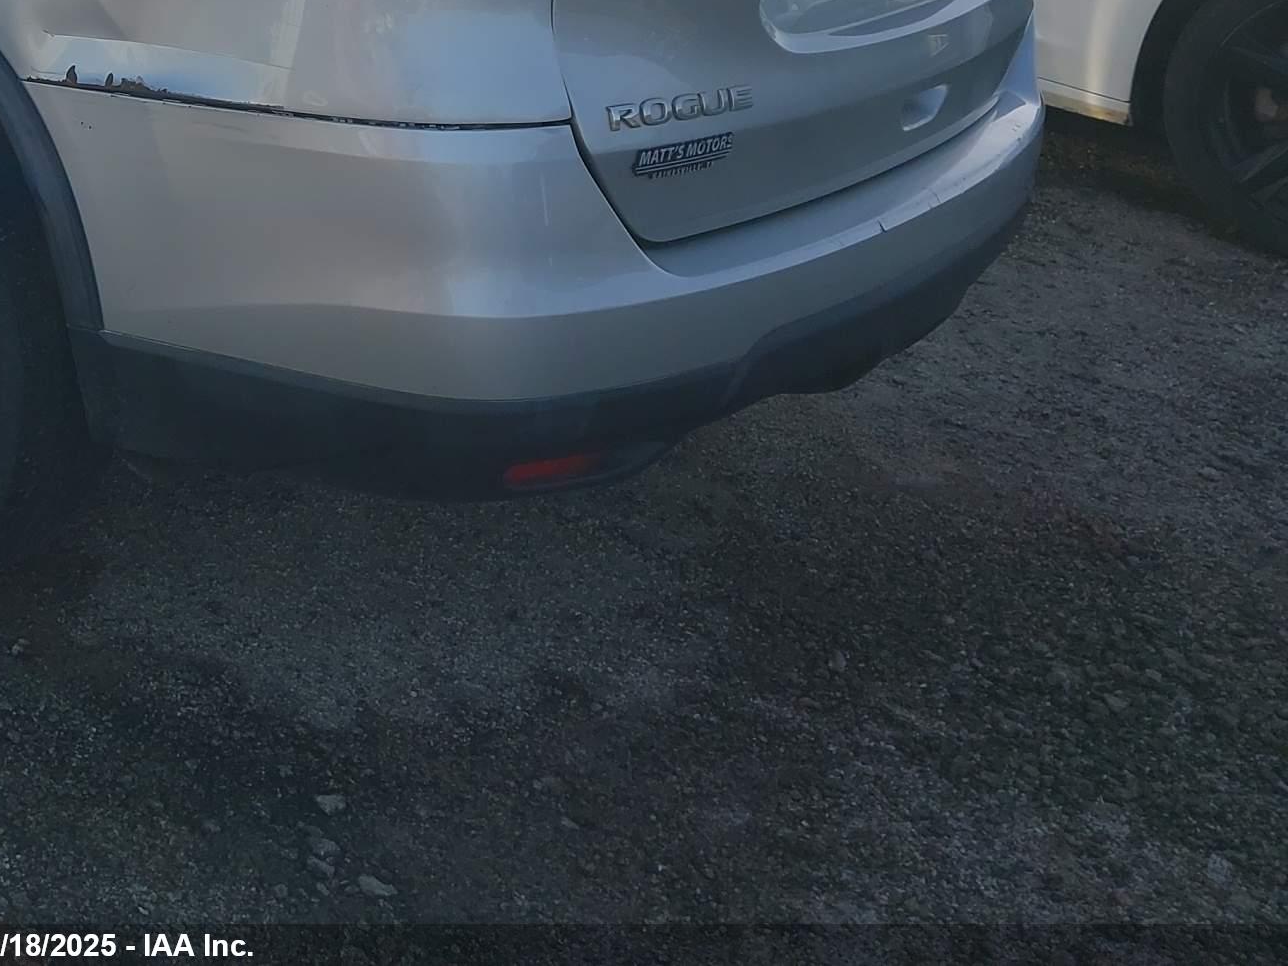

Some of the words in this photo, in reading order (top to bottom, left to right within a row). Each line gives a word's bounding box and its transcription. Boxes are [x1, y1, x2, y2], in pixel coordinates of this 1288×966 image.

[605, 85, 754, 132] ROGUE
[639, 144, 685, 167] MATT'S
[685, 135, 733, 158] MOTORS
